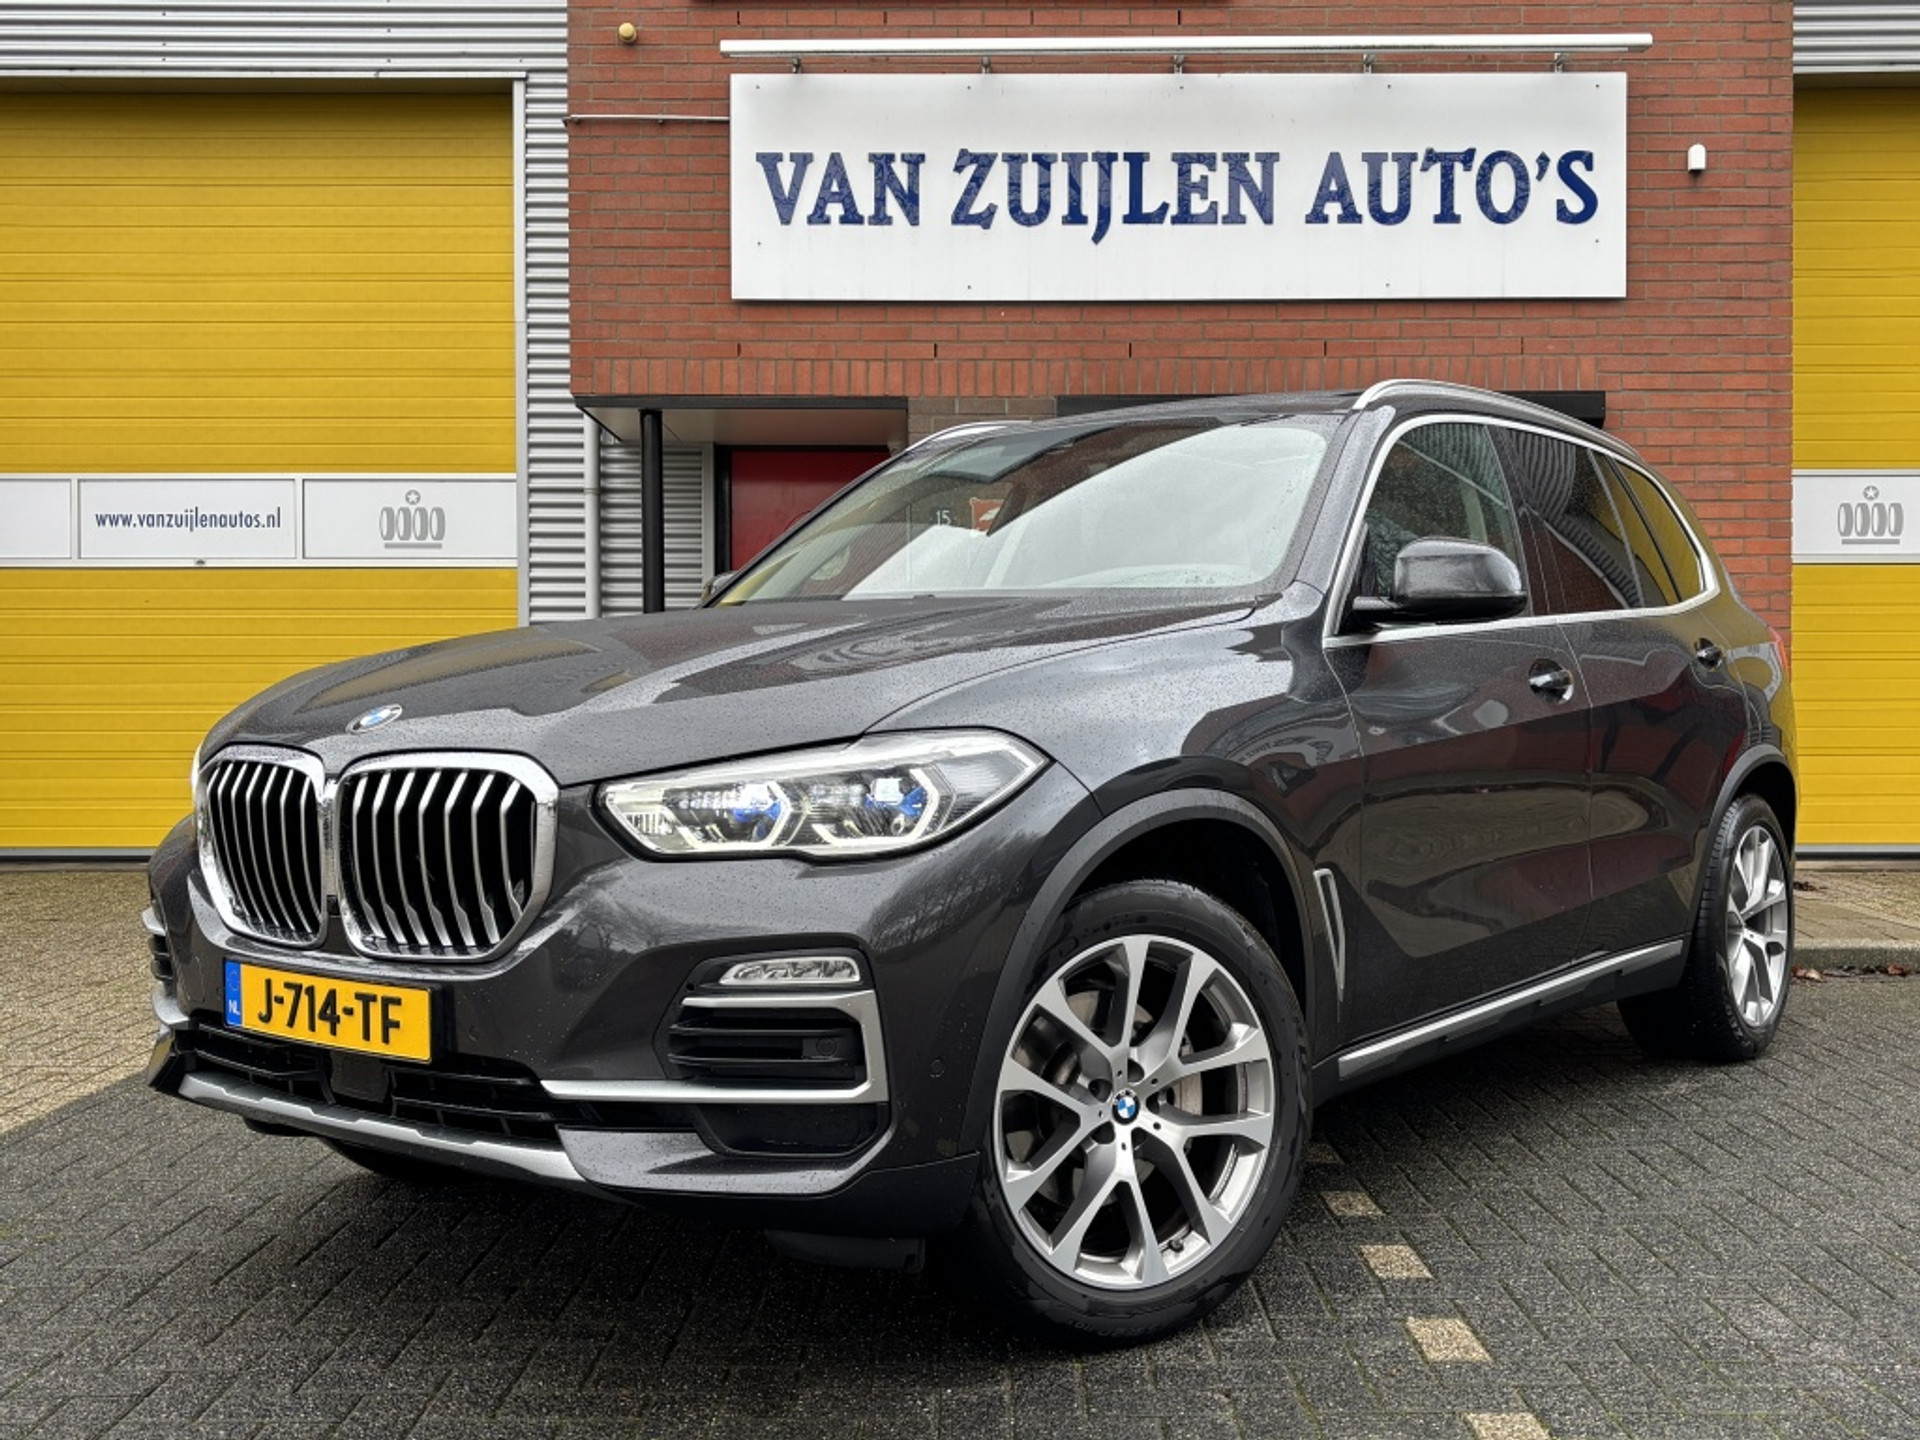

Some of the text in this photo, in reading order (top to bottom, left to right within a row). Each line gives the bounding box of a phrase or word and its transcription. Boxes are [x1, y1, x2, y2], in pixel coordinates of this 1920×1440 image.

[756, 148, 1596, 245] VAN ZUIJLEN AUTO'S
[95, 506, 281, 532] www.vanzuijlenautos.nl
[935, 510, 952, 527] 15
[228, 999, 241, 1016] NL
[258, 978, 402, 1044] J-714-TF
